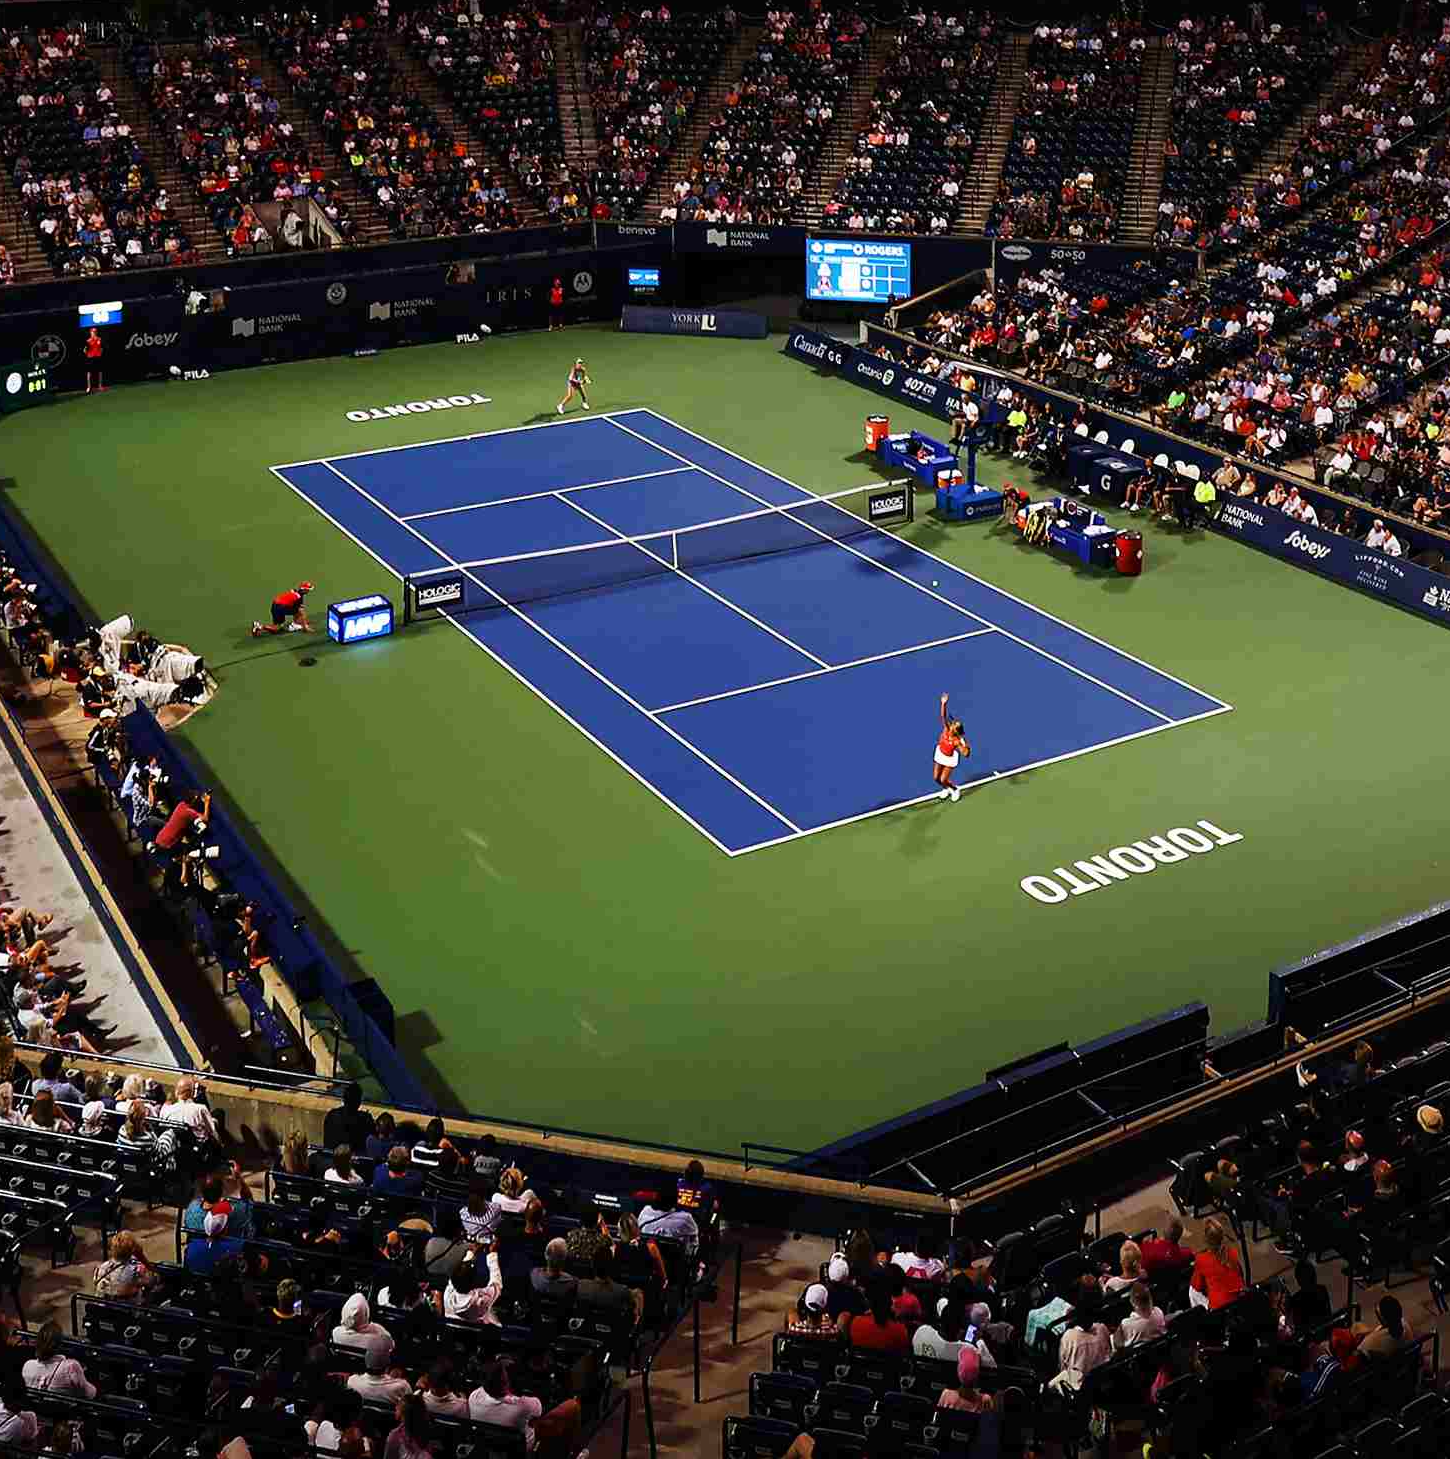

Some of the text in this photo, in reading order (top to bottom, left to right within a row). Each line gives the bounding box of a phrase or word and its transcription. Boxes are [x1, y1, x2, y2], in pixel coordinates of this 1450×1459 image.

[730, 230, 769, 240] NATIONAL
[730, 239, 753, 247] BANK
[864, 244, 904, 256] ROGERS
[394, 297, 436, 309] NATIONAL
[258, 313, 301, 325] NATIONAL
[394, 307, 419, 318] BANK
[671, 313, 700, 324] YORK
[258, 323, 285, 333] BANK
[125, 331, 180, 348] Sobeys
[456, 333, 480, 343] FILA
[793, 334, 828, 359] Canada
[184, 369, 210, 380] FILA
[857, 363, 883, 380] Ontario
[904, 376, 924, 392] 407
[346, 393, 492, 422] TORONTO
[1101, 475, 1111, 490] G
[871, 496, 903, 510] HOLOGIC
[1221, 513, 1245, 529] BANK
[1225, 504, 1264, 526] NATIONAL
[1284, 530, 1331, 558] Sobeys
[418, 583, 461, 598] HOLOGIC
[1020, 820, 1245, 904] TORONTO
